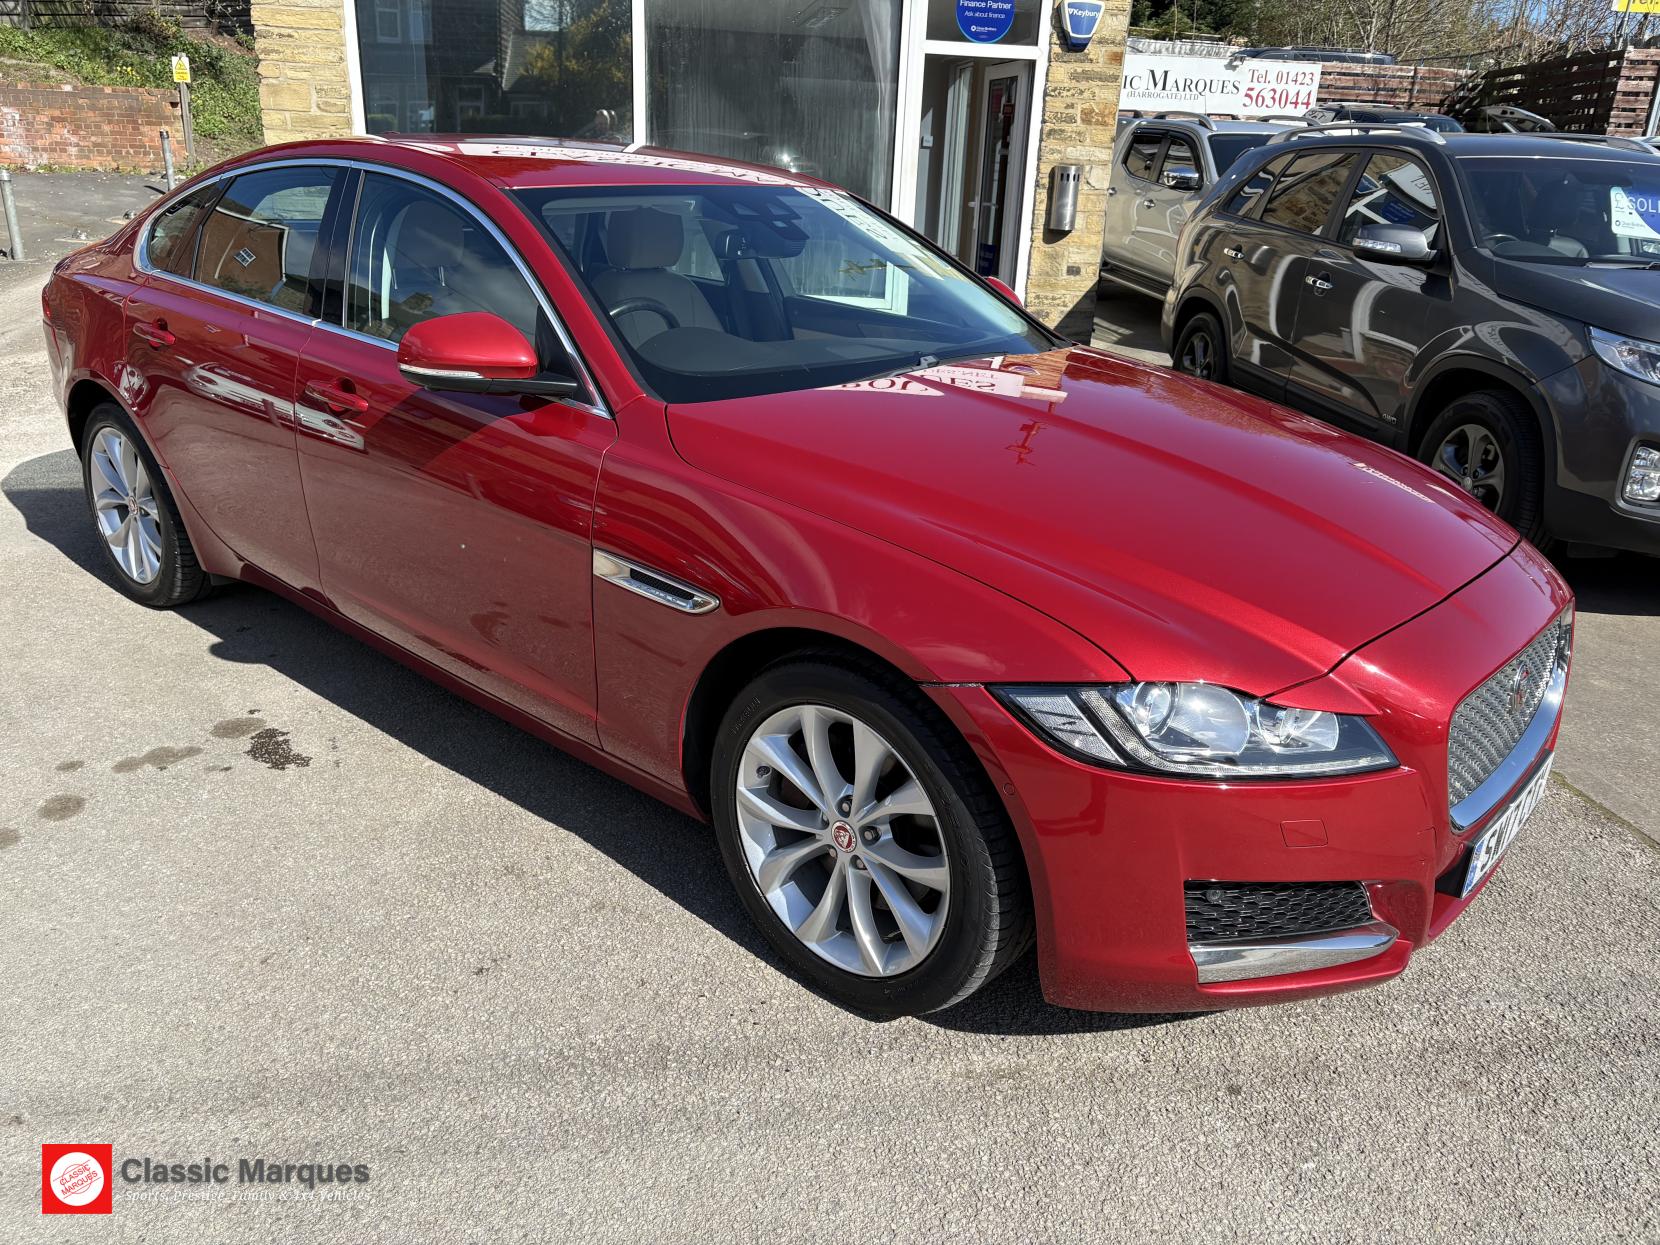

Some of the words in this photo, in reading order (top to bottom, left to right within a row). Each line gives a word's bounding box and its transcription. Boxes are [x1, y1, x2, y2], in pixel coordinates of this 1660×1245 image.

[960, 0, 986, 8] Finance
[987, 1, 1012, 10] Partner
[1073, 8, 1099, 19] Keybury
[1248, 68, 1271, 84] Tel.
[1275, 70, 1315, 86] 01423
[1126, 91, 1183, 101] (HARROGATE)
[1183, 92, 1199, 101] LTD
[1242, 87, 1313, 110] 563044
